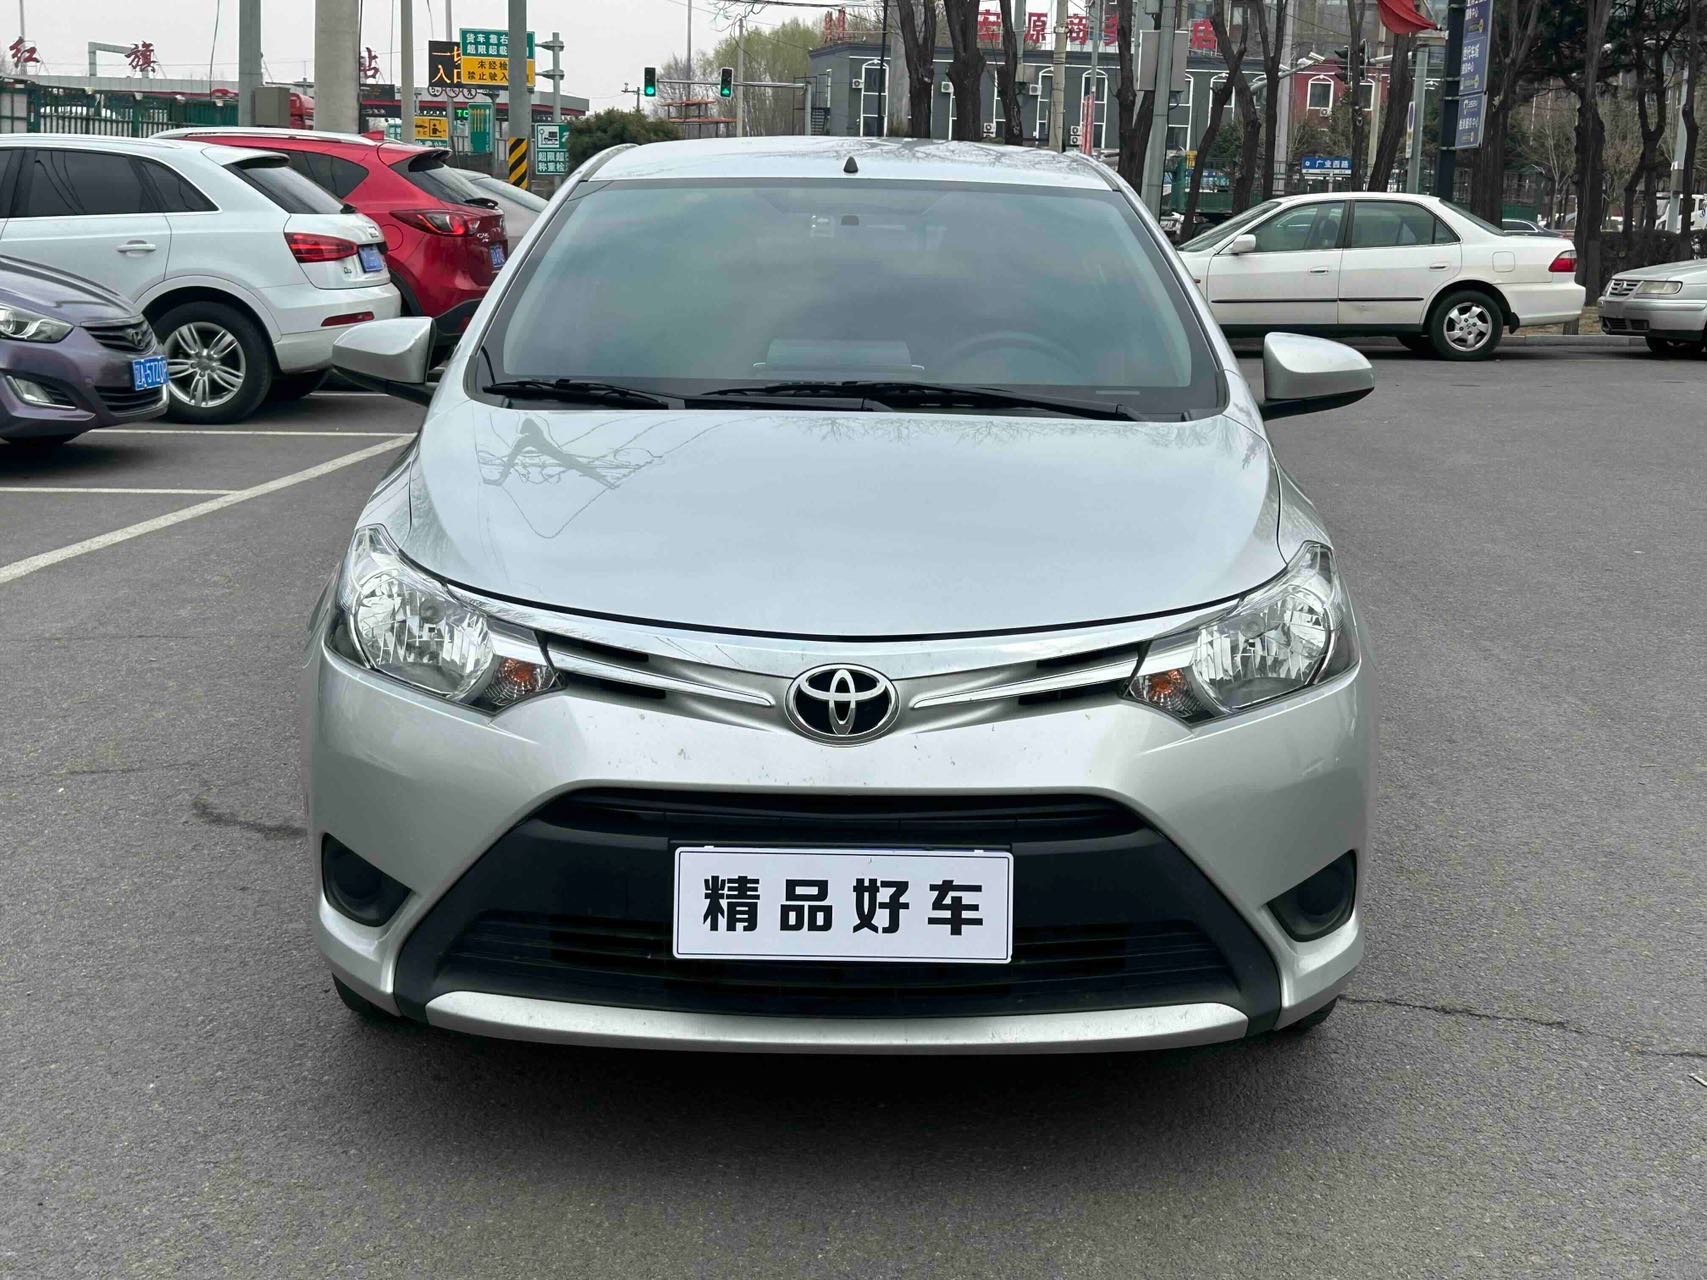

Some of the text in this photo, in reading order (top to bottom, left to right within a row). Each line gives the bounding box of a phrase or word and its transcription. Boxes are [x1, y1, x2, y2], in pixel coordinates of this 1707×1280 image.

[466, 44, 529, 56] 超限超载
[466, 70, 530, 82] 禁止驶入
[703, 875, 984, 936] 精品好车
